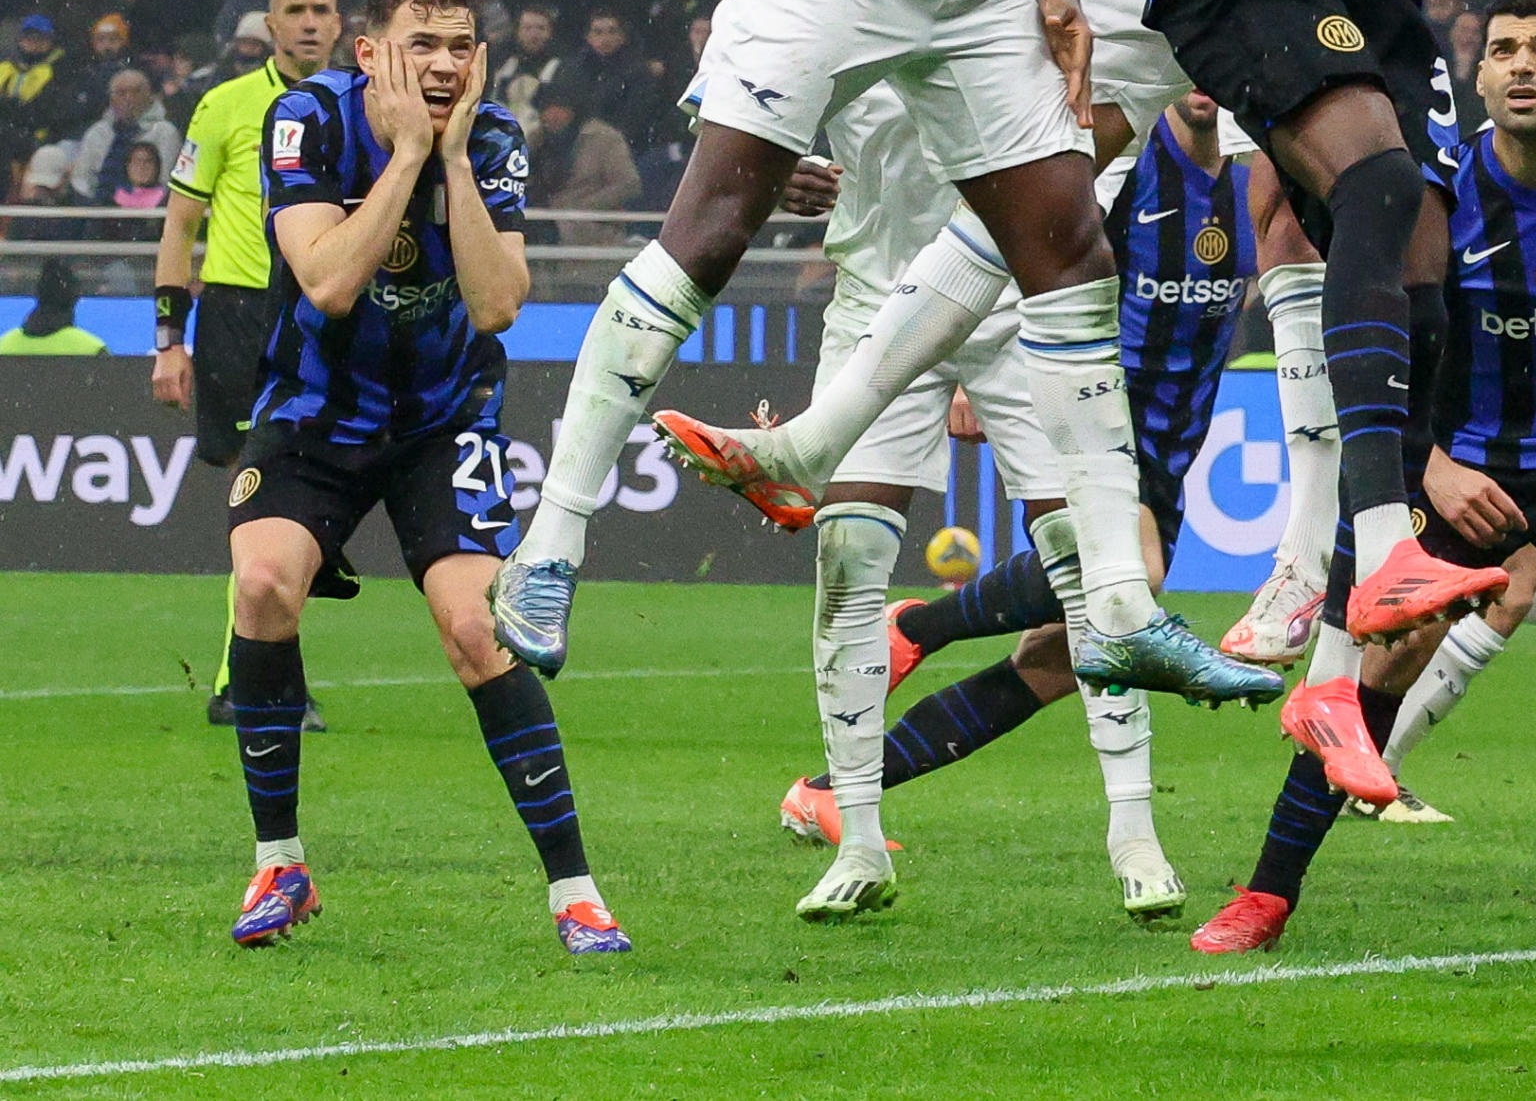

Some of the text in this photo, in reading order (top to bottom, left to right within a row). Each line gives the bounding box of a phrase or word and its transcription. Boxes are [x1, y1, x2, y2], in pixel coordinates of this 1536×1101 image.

[1136, 272, 1244, 304] betsso
[0, 434, 198, 526] way
[452, 431, 507, 499] 21
